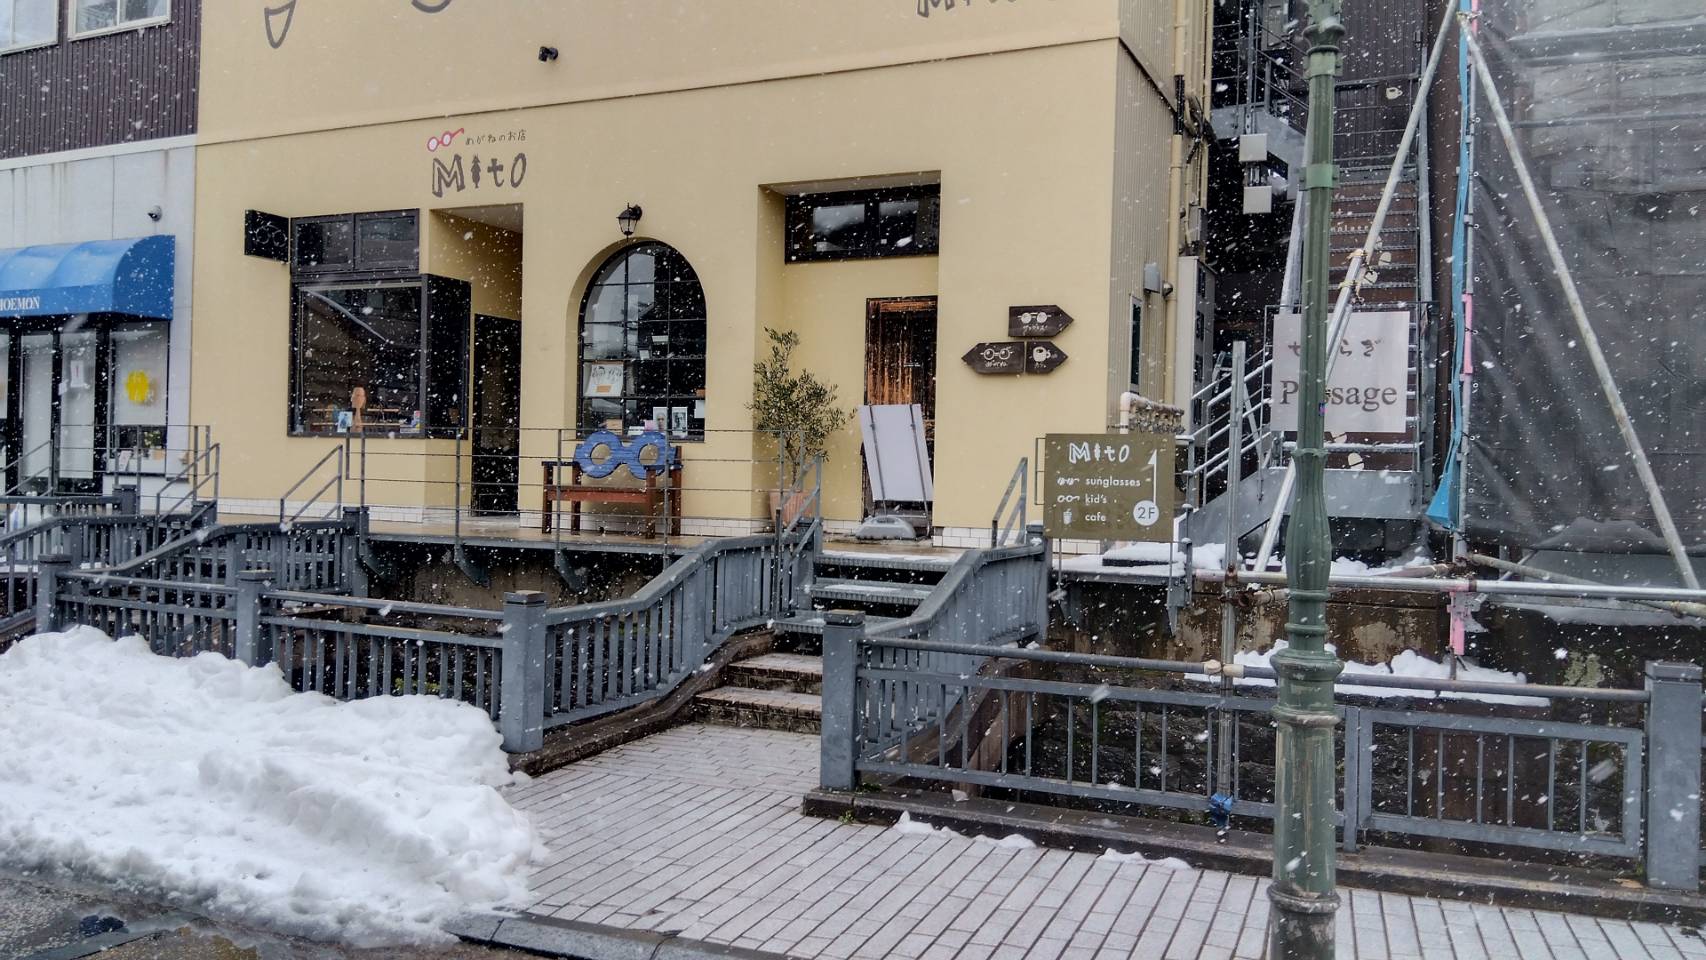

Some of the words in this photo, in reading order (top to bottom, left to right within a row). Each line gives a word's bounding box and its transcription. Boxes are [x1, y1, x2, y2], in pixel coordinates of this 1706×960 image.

[1280, 380, 1397, 412] Psage
[1085, 476, 1141, 488] sunglasses
[1085, 494, 1107, 505] kid's
[1085, 512, 1106, 522] cafe
[1137, 507, 1155, 519] 2F
